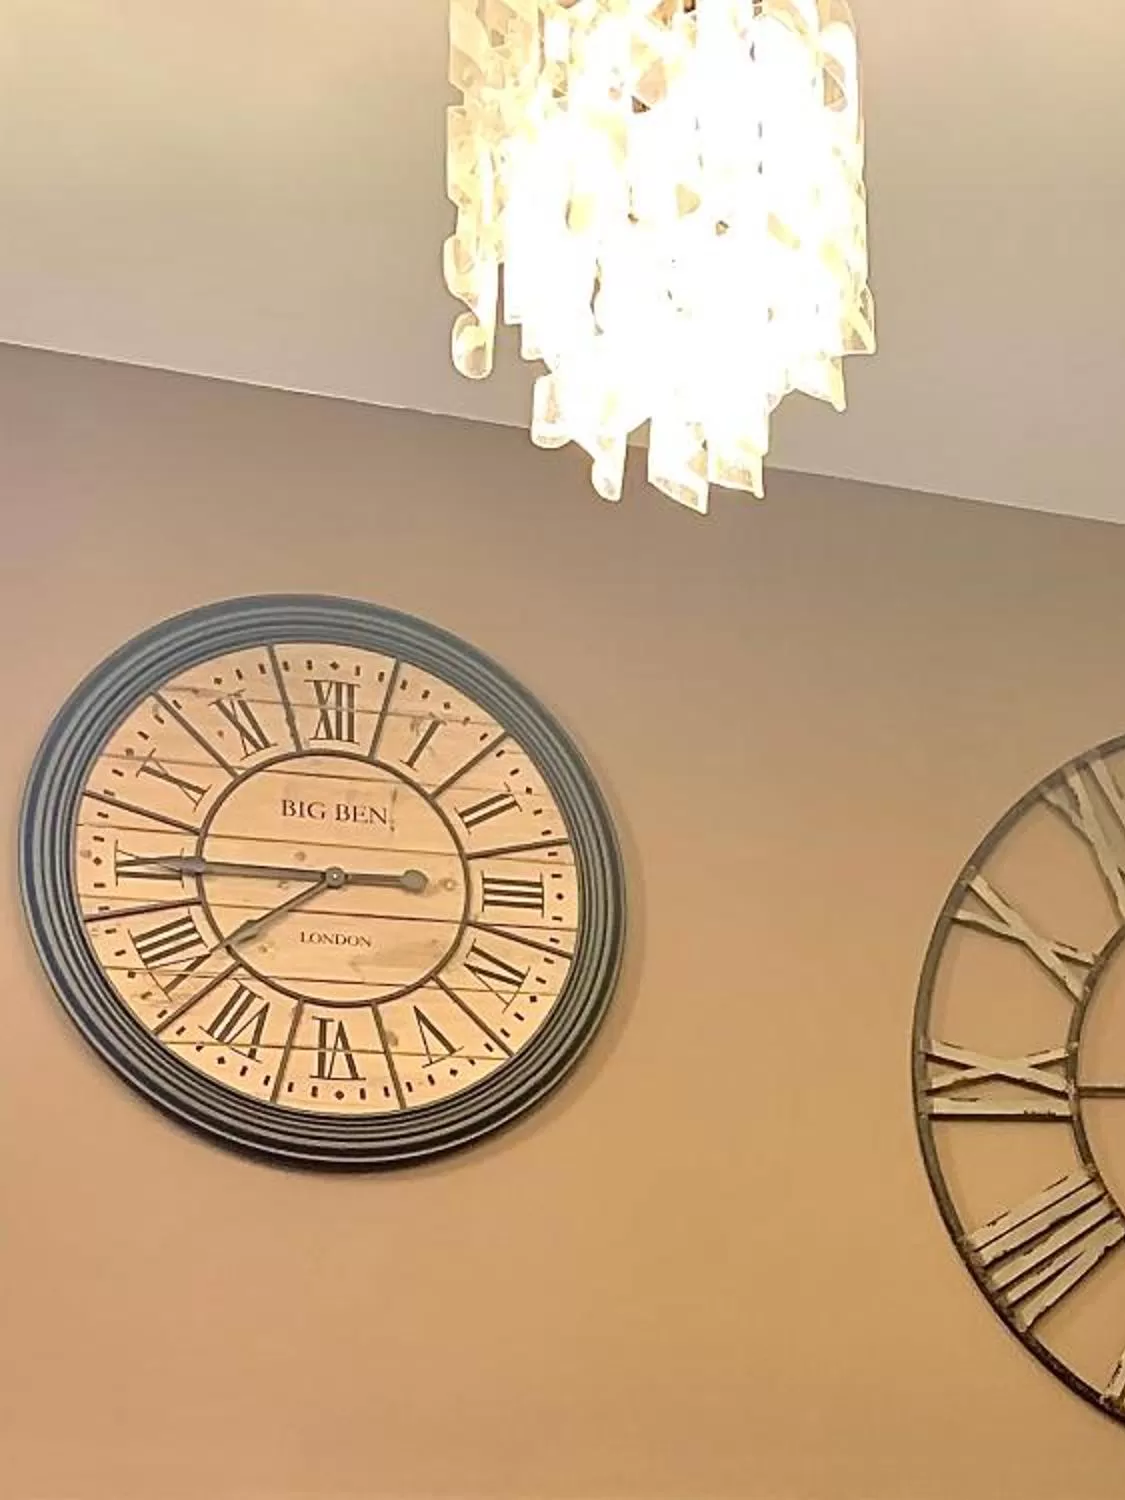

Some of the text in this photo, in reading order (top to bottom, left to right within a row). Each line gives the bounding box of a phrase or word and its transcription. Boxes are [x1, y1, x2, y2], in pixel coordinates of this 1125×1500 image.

[306, 679, 360, 745] XII
[282, 799, 388, 825] BIG BEN
[481, 869, 545, 917] III
[300, 930, 372, 948] LONDON
